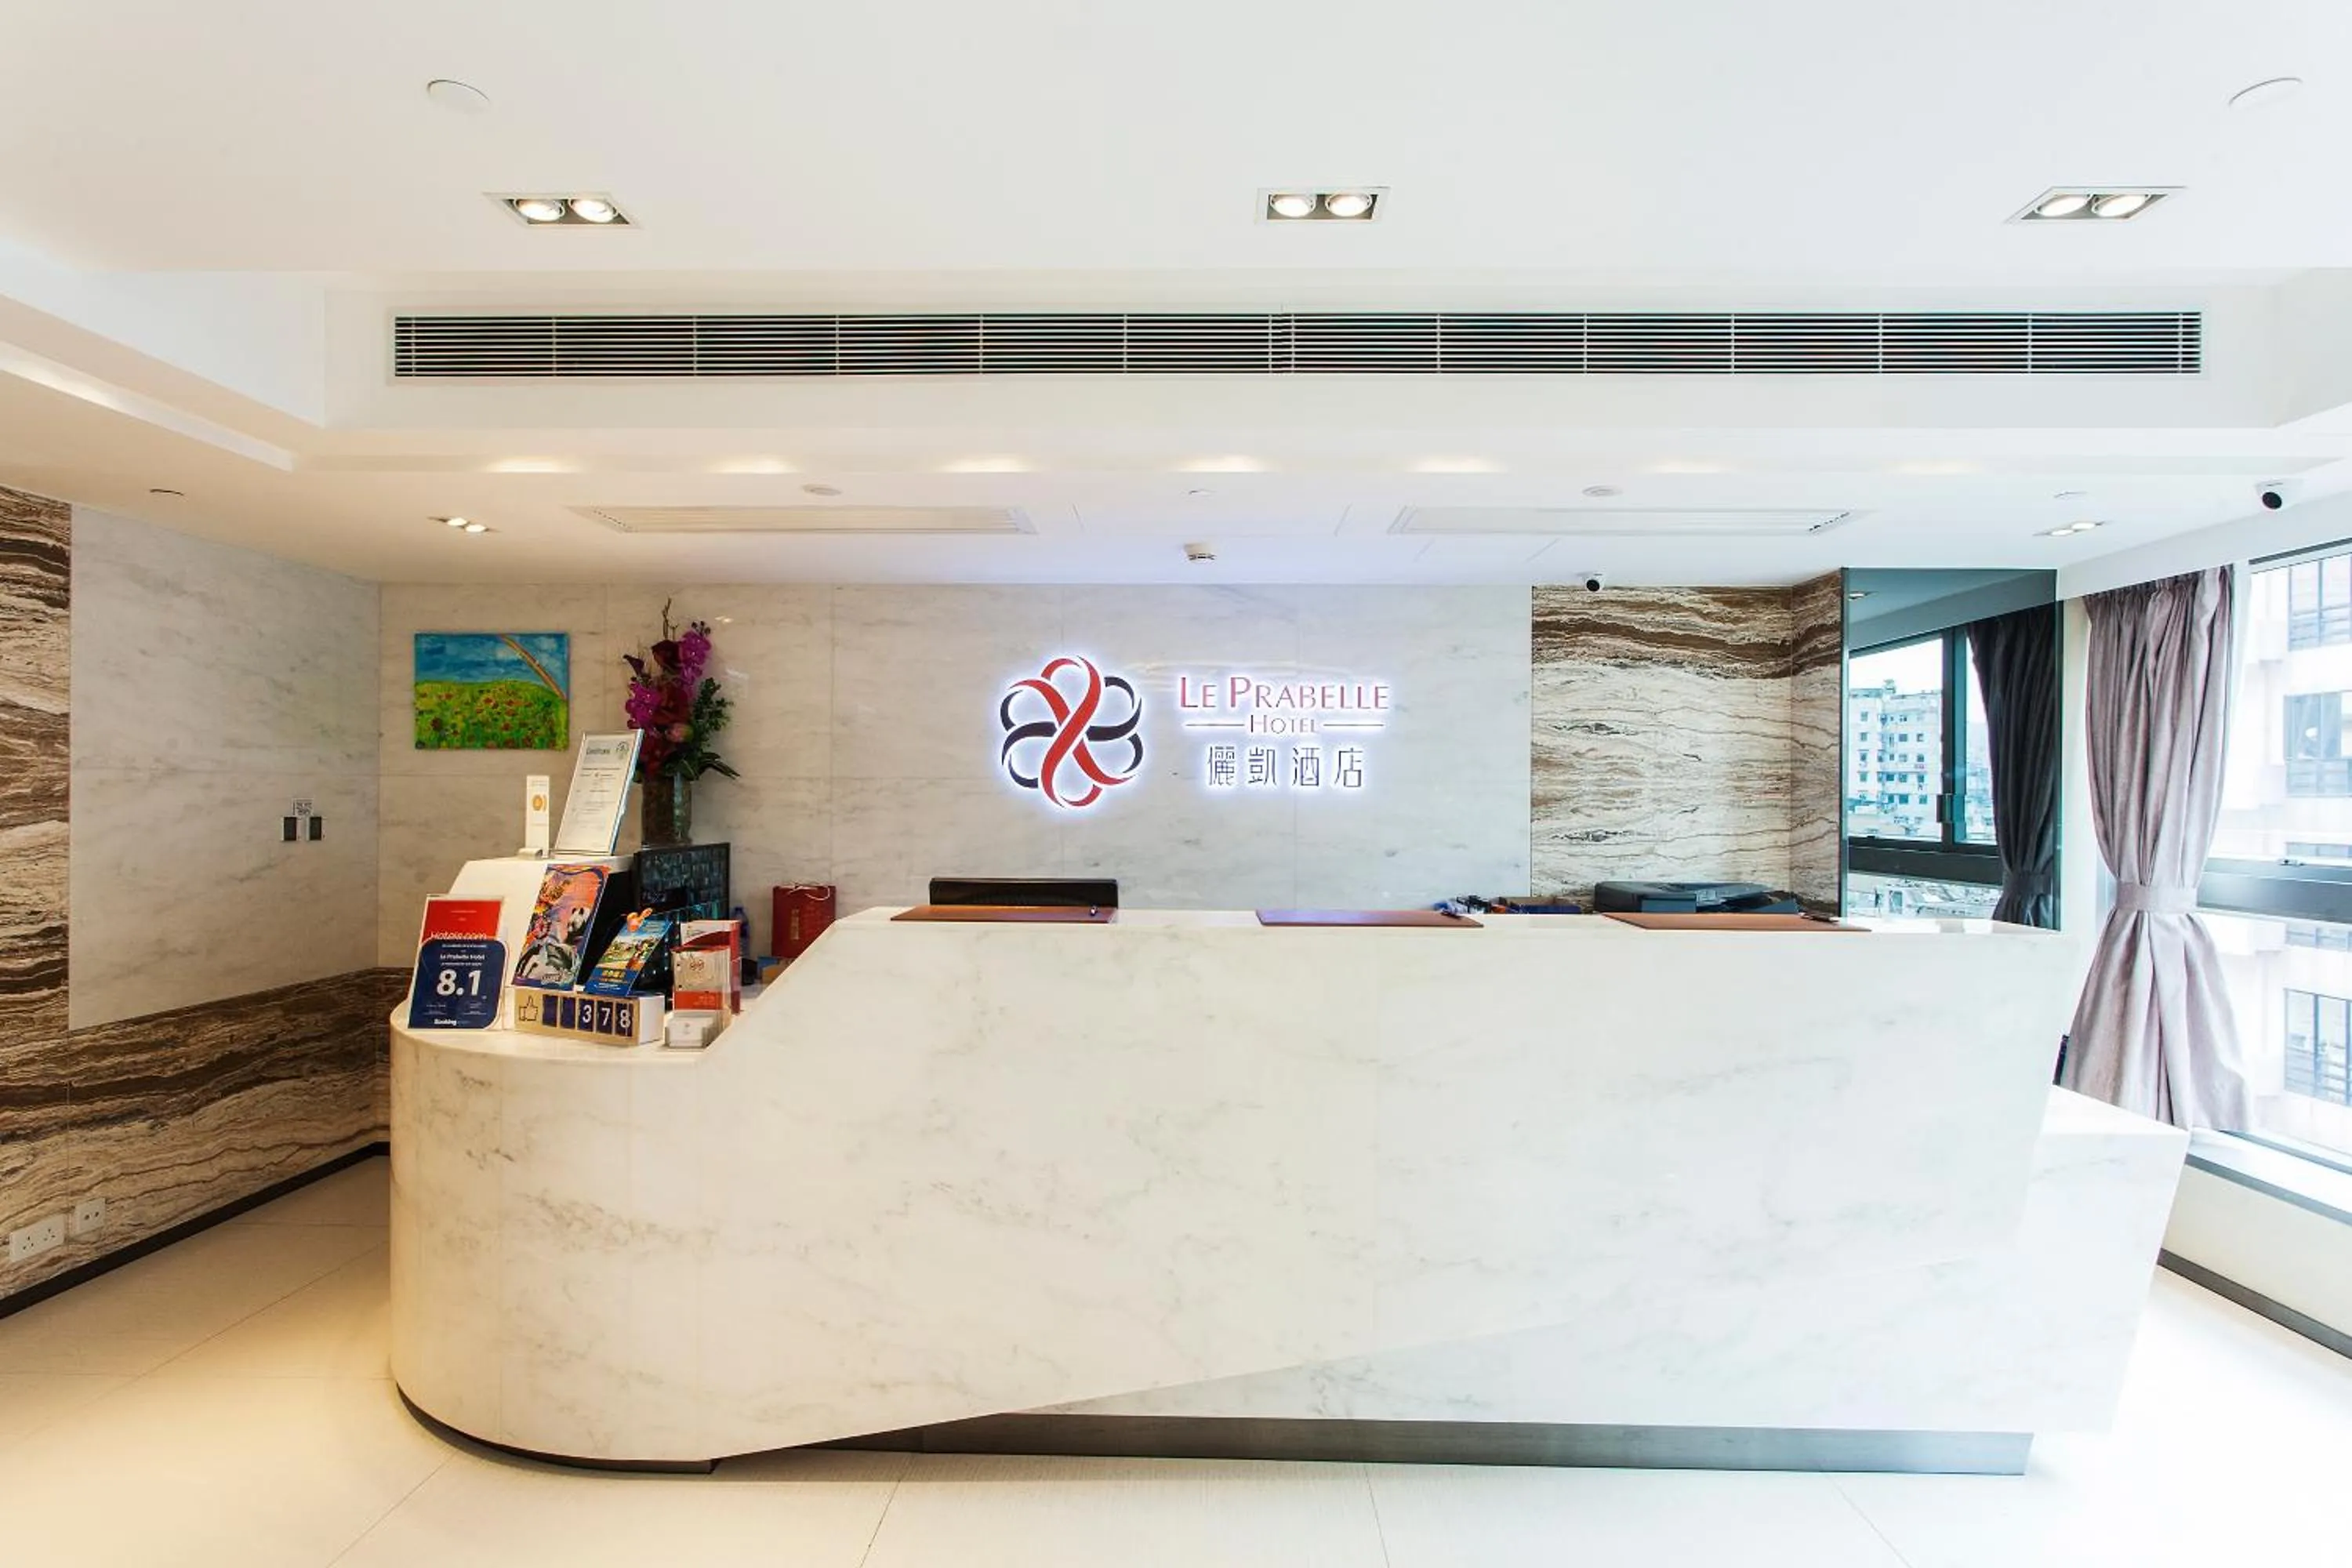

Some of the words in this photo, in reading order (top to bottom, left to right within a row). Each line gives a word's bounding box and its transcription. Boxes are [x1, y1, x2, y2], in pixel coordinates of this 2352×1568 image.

[1180, 677, 1217, 708] LE
[1229, 677, 1390, 709] PRABELLE
[1250, 714, 1319, 734] HOTEL
[1207, 746, 1363, 788] 儷凱酒店
[436, 968, 482, 996] 8.1
